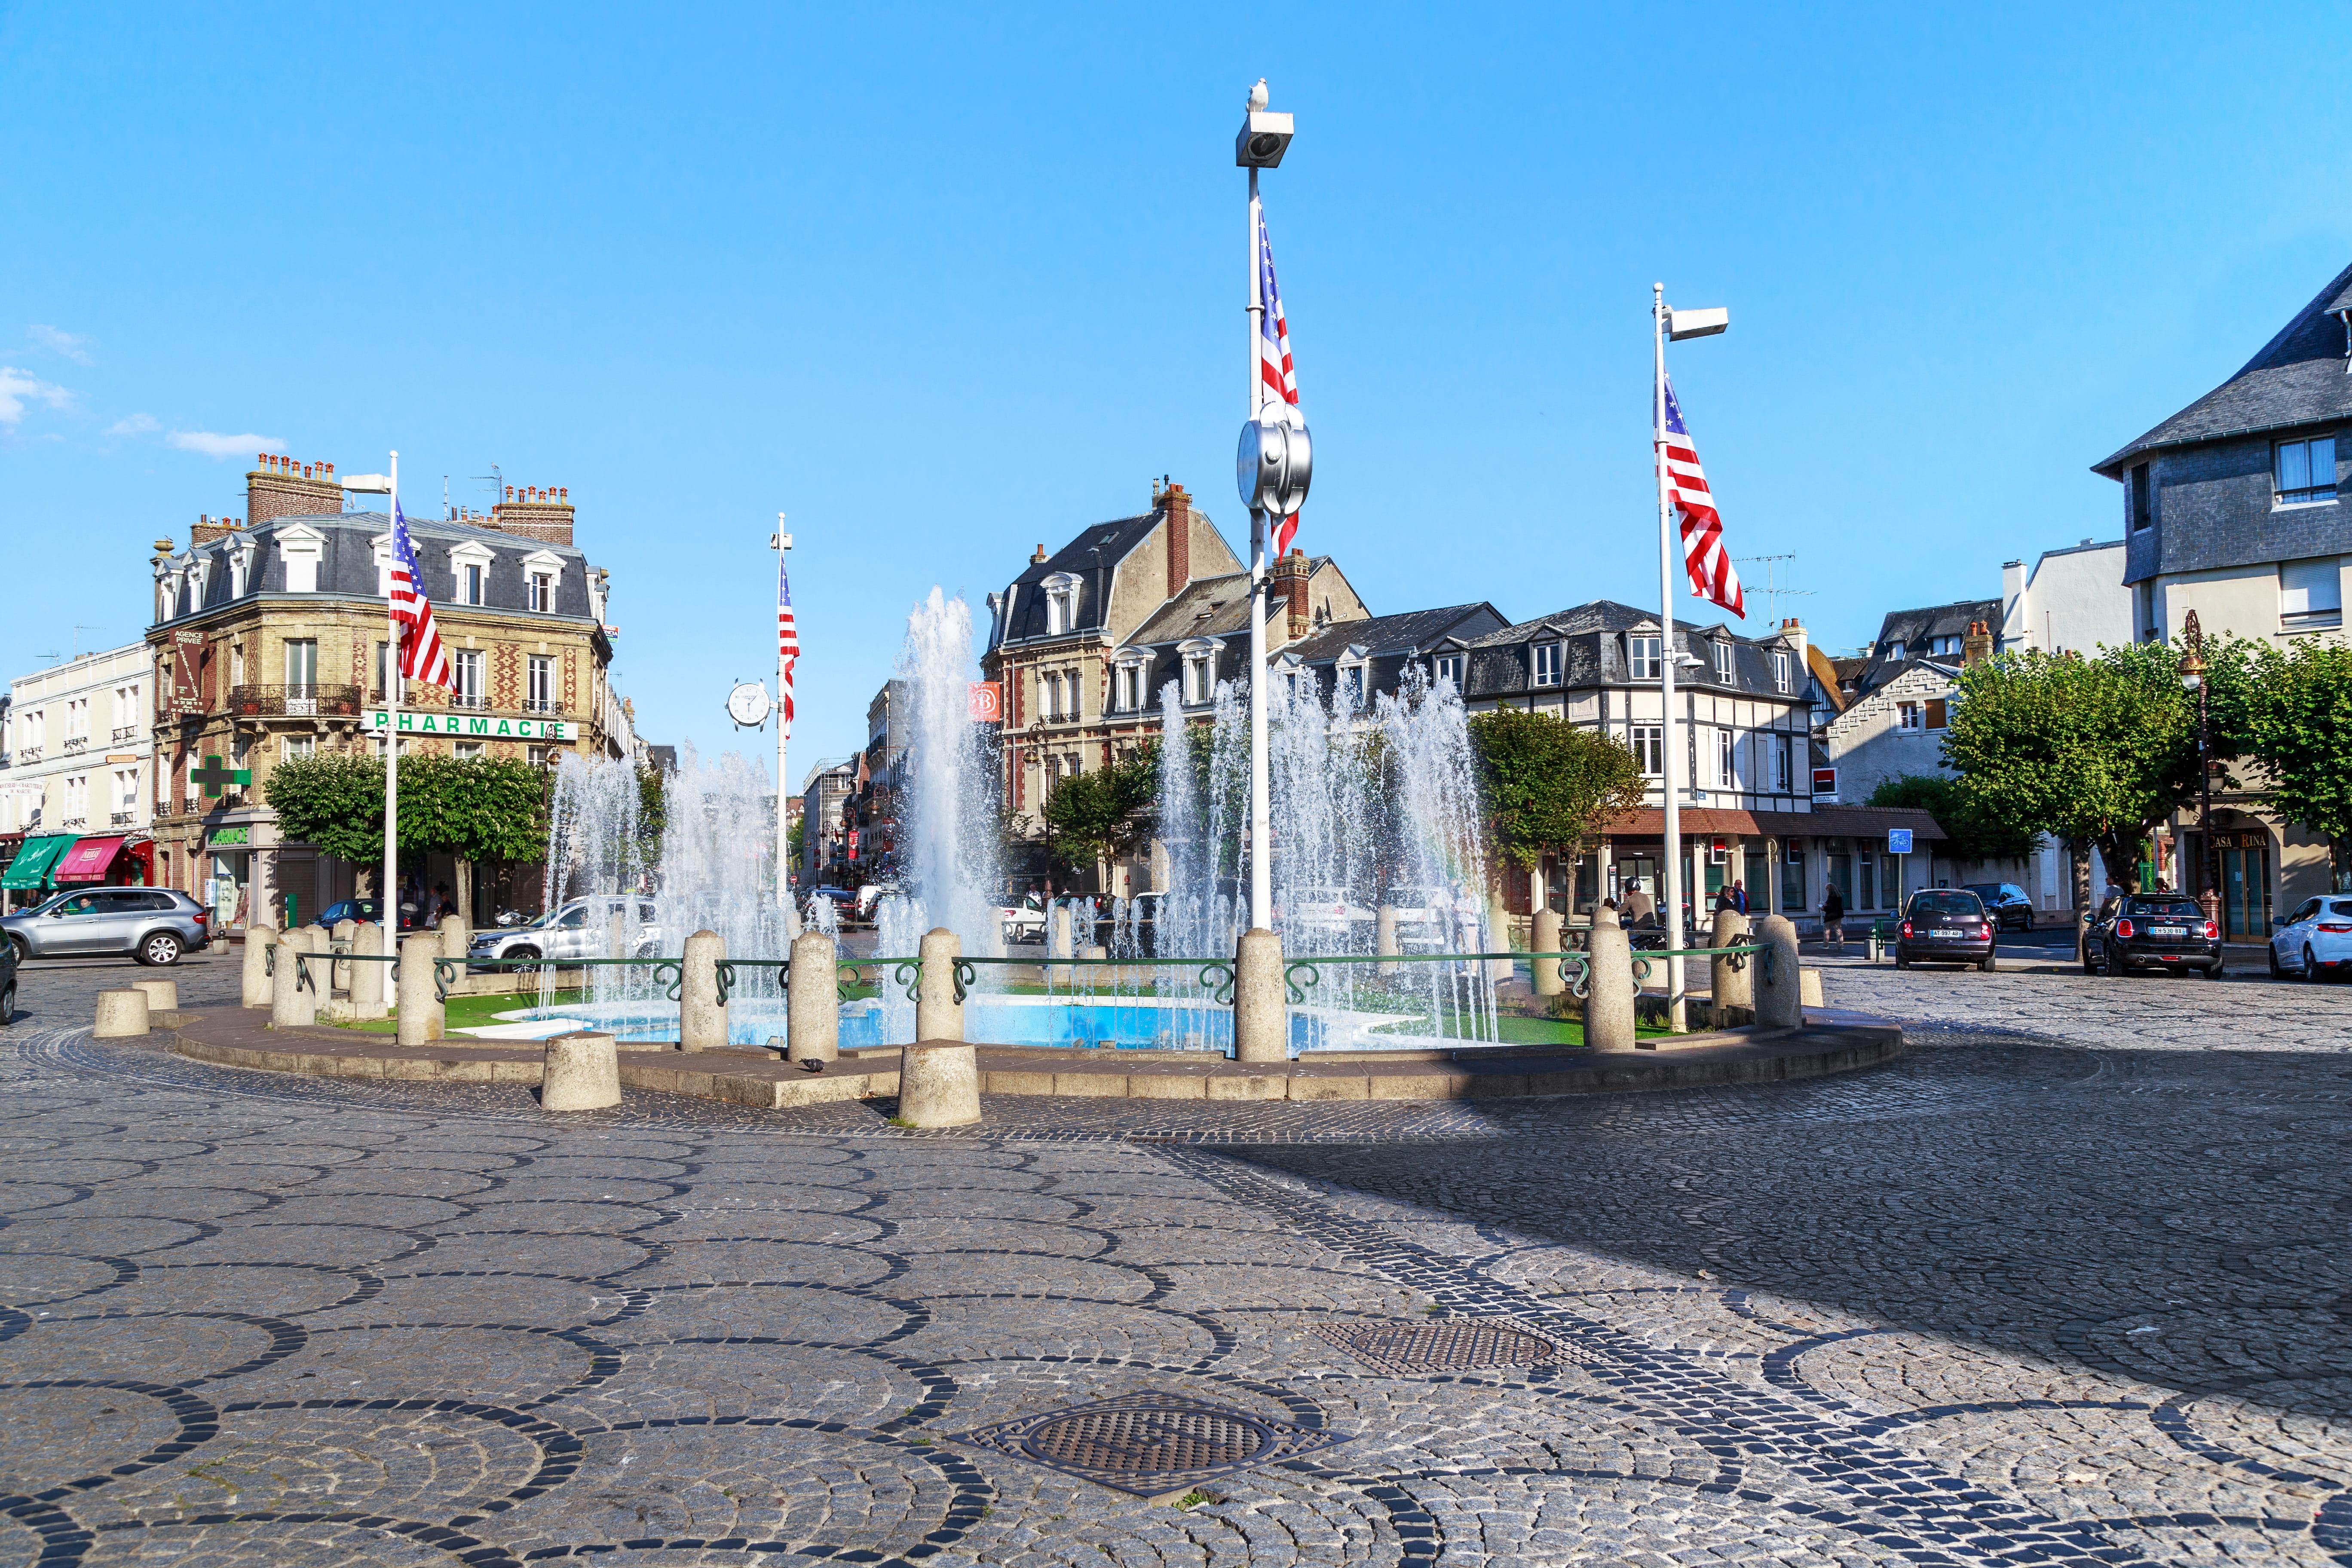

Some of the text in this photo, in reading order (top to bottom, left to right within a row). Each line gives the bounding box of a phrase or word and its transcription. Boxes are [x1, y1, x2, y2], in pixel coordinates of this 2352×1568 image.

[976, 693, 991, 709] B
[376, 713, 564, 738] PHARMACIE
[2210, 834, 2266, 848] CASA RINA
